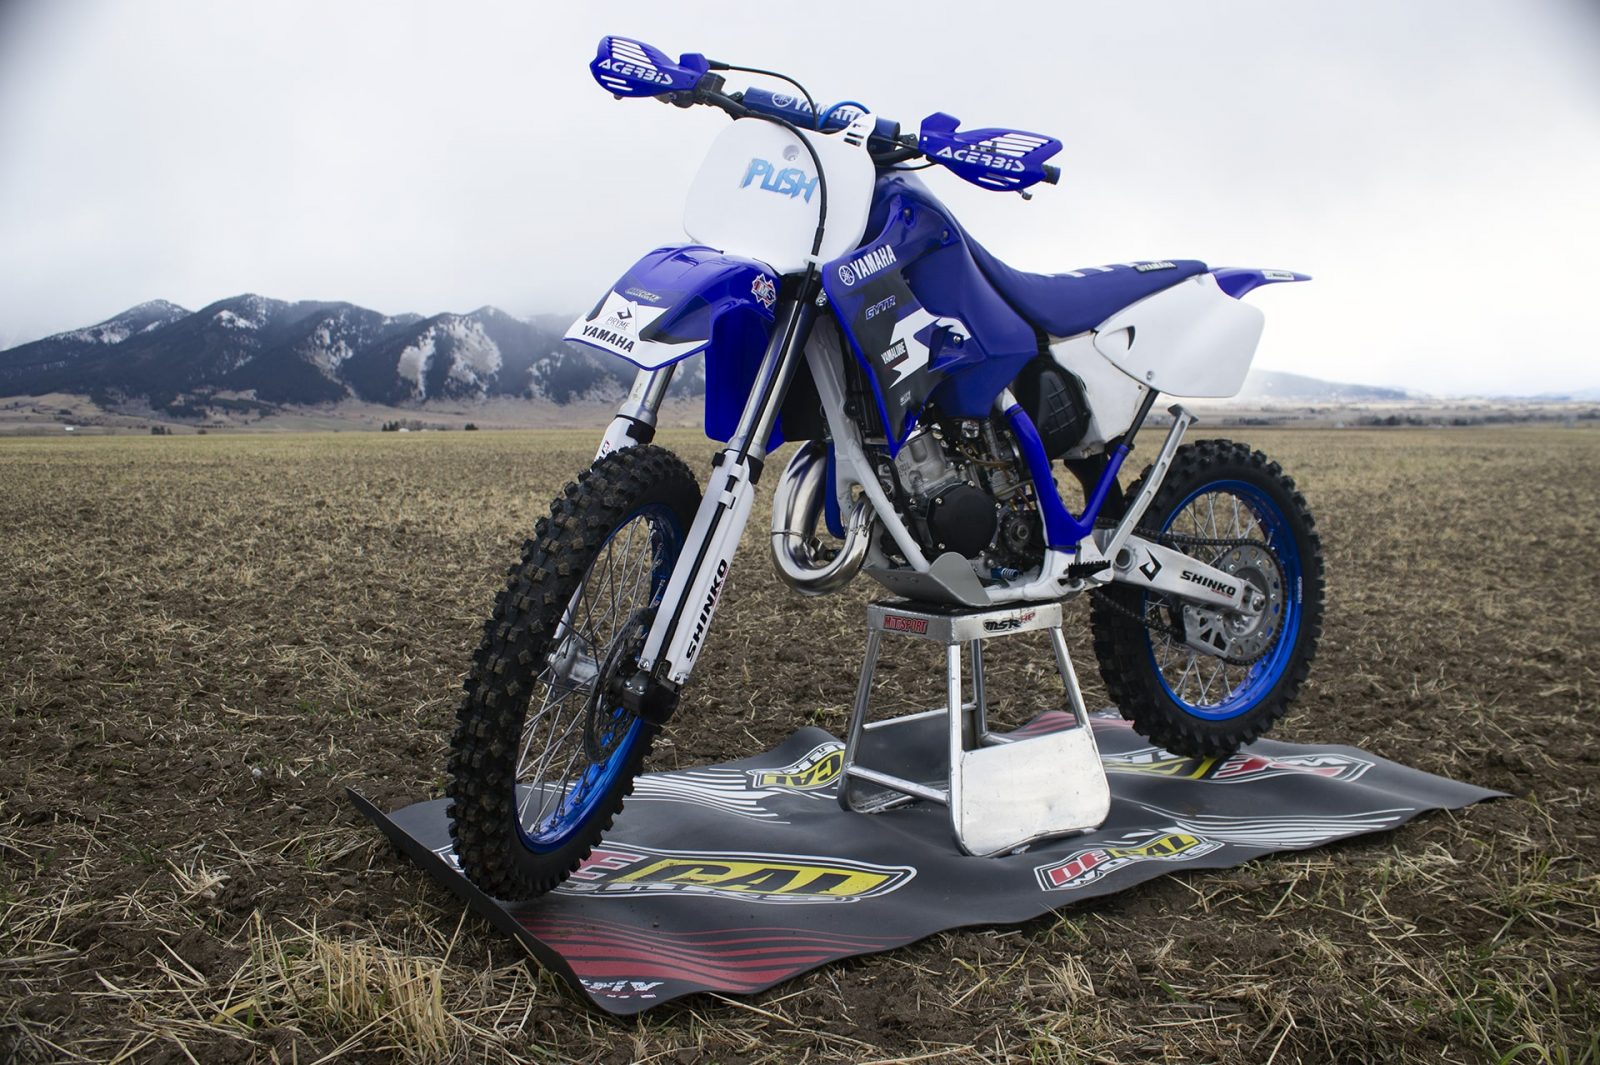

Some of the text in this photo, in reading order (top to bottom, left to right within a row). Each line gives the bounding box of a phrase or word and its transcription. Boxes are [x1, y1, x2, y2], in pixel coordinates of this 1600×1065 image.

[741, 157, 819, 204] PUSH
[849, 244, 897, 280] YAMAHA
[865, 295, 896, 320] GYTR
[582, 325, 635, 353] YAMAHA
[1180, 570, 1236, 596] SHINKO
[686, 558, 728, 662] SHINKO
